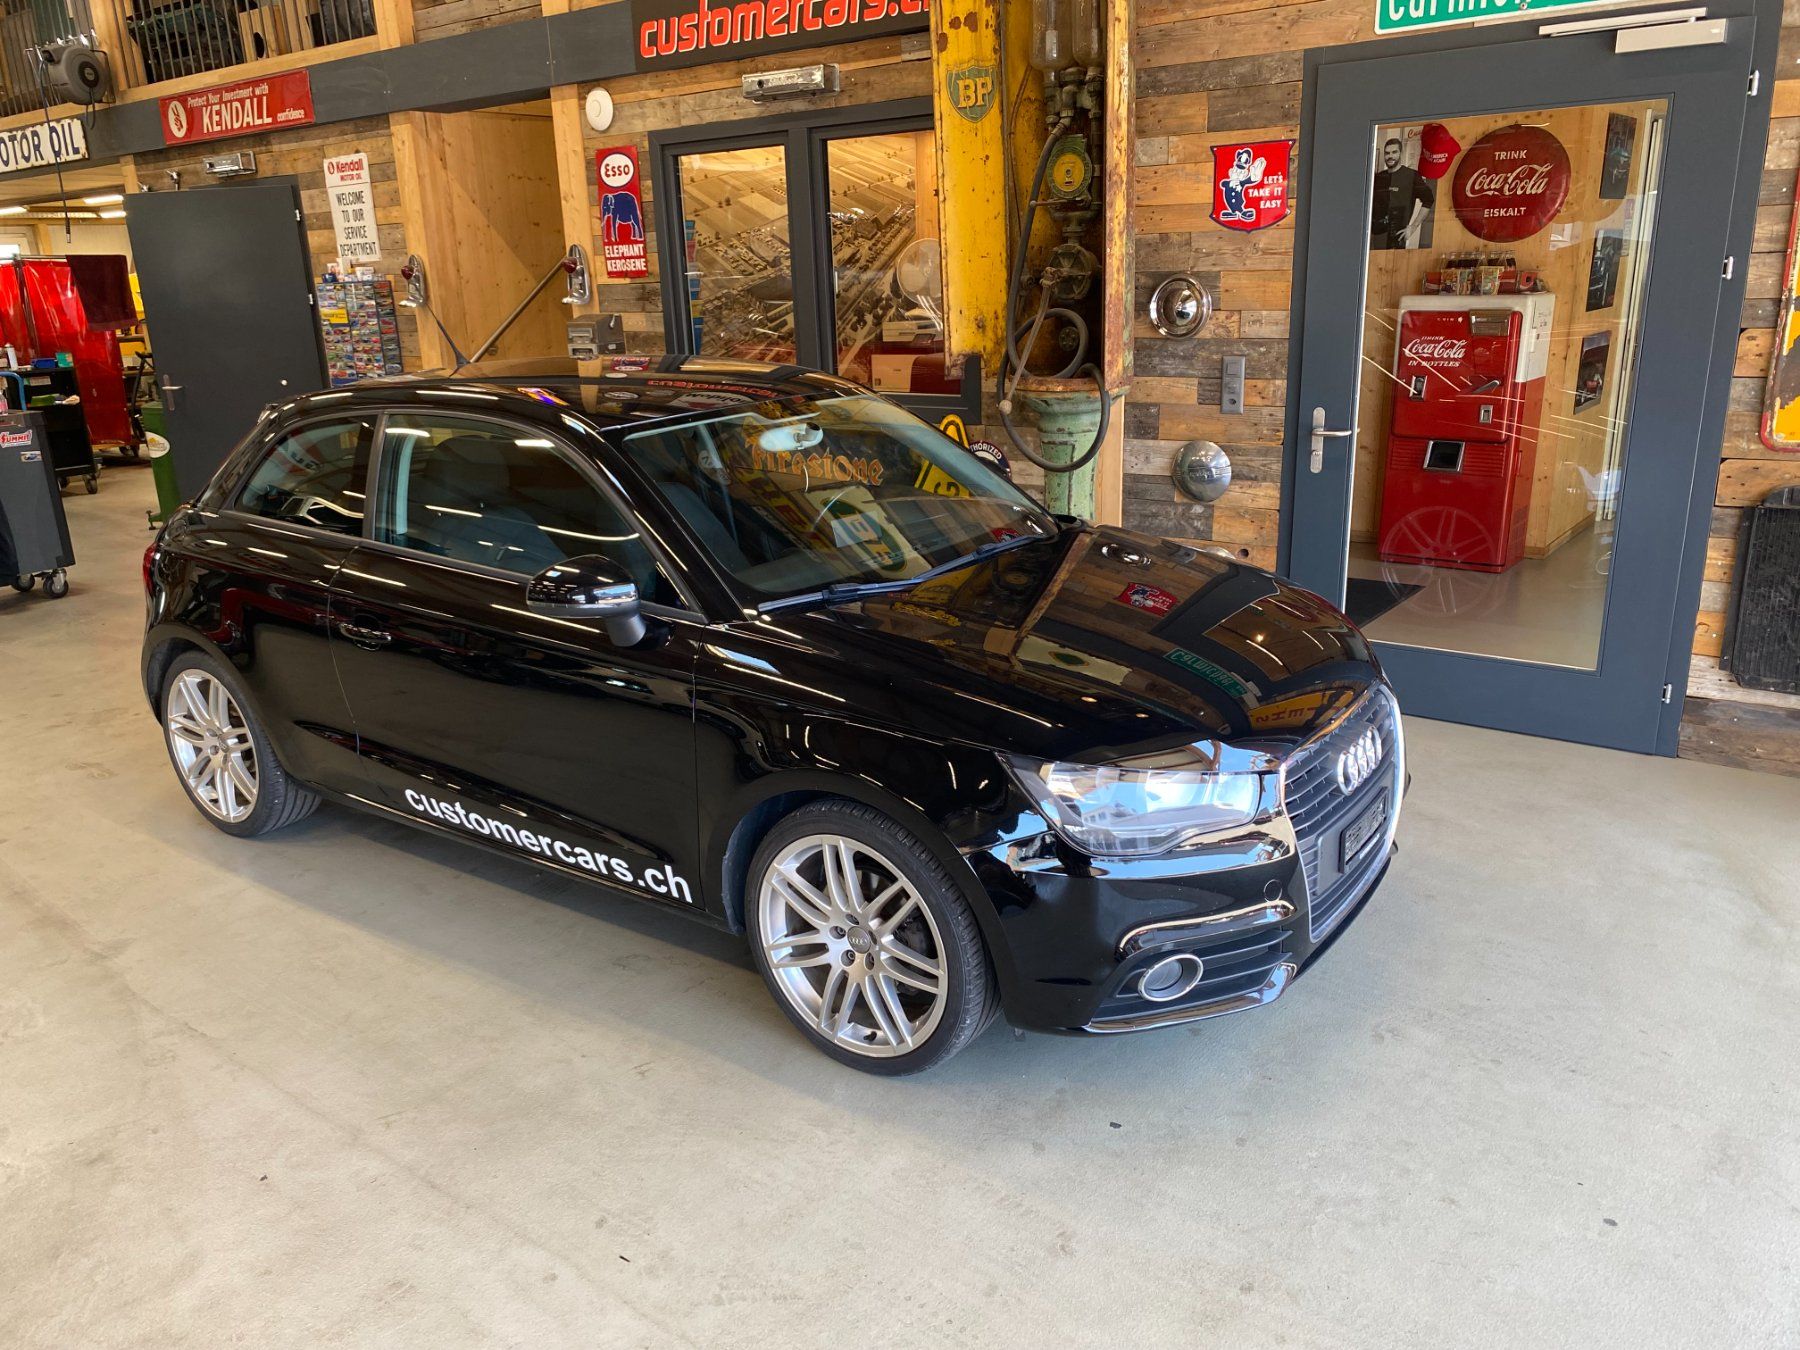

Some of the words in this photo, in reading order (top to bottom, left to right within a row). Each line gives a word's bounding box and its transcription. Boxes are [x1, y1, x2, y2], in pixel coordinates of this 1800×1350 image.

[640, 0, 931, 58] customercars.
[188, 95, 207, 108] Protect
[208, 92, 220, 105] Your
[222, 87, 253, 102] Investment
[255, 82, 269, 96] with
[956, 76, 993, 108] BP
[202, 96, 272, 133] KENDALL
[276, 108, 305, 122] confidence
[0, 130, 44, 167] OTOR
[49, 122, 80, 159] OIL
[1494, 149, 1528, 161] TRINK
[336, 158, 364, 173] Kendall
[604, 163, 630, 178] Esso
[340, 173, 355, 182] MOTOR
[355, 172, 363, 181] OIL
[1264, 173, 1284, 184] LET'S
[1465, 163, 1554, 198] Coca-Cola
[336, 190, 365, 206] WELCOME
[1248, 188, 1270, 197] TAKE
[1273, 187, 1283, 196] IT
[1260, 199, 1282, 209] EASY
[342, 210, 350, 223] TO
[352, 208, 365, 222] OUR
[1484, 207, 1526, 218] EISKALT
[344, 225, 368, 240] SERVICE
[340, 241, 377, 257] DEPARTMENT
[605, 243, 644, 258] ELEPHANT
[607, 258, 647, 272] KEROSENE
[1405, 338, 1467, 359] Coca-Cola
[969, 442, 1003, 460] THORIZED
[405, 788, 693, 904] customercars.ch
